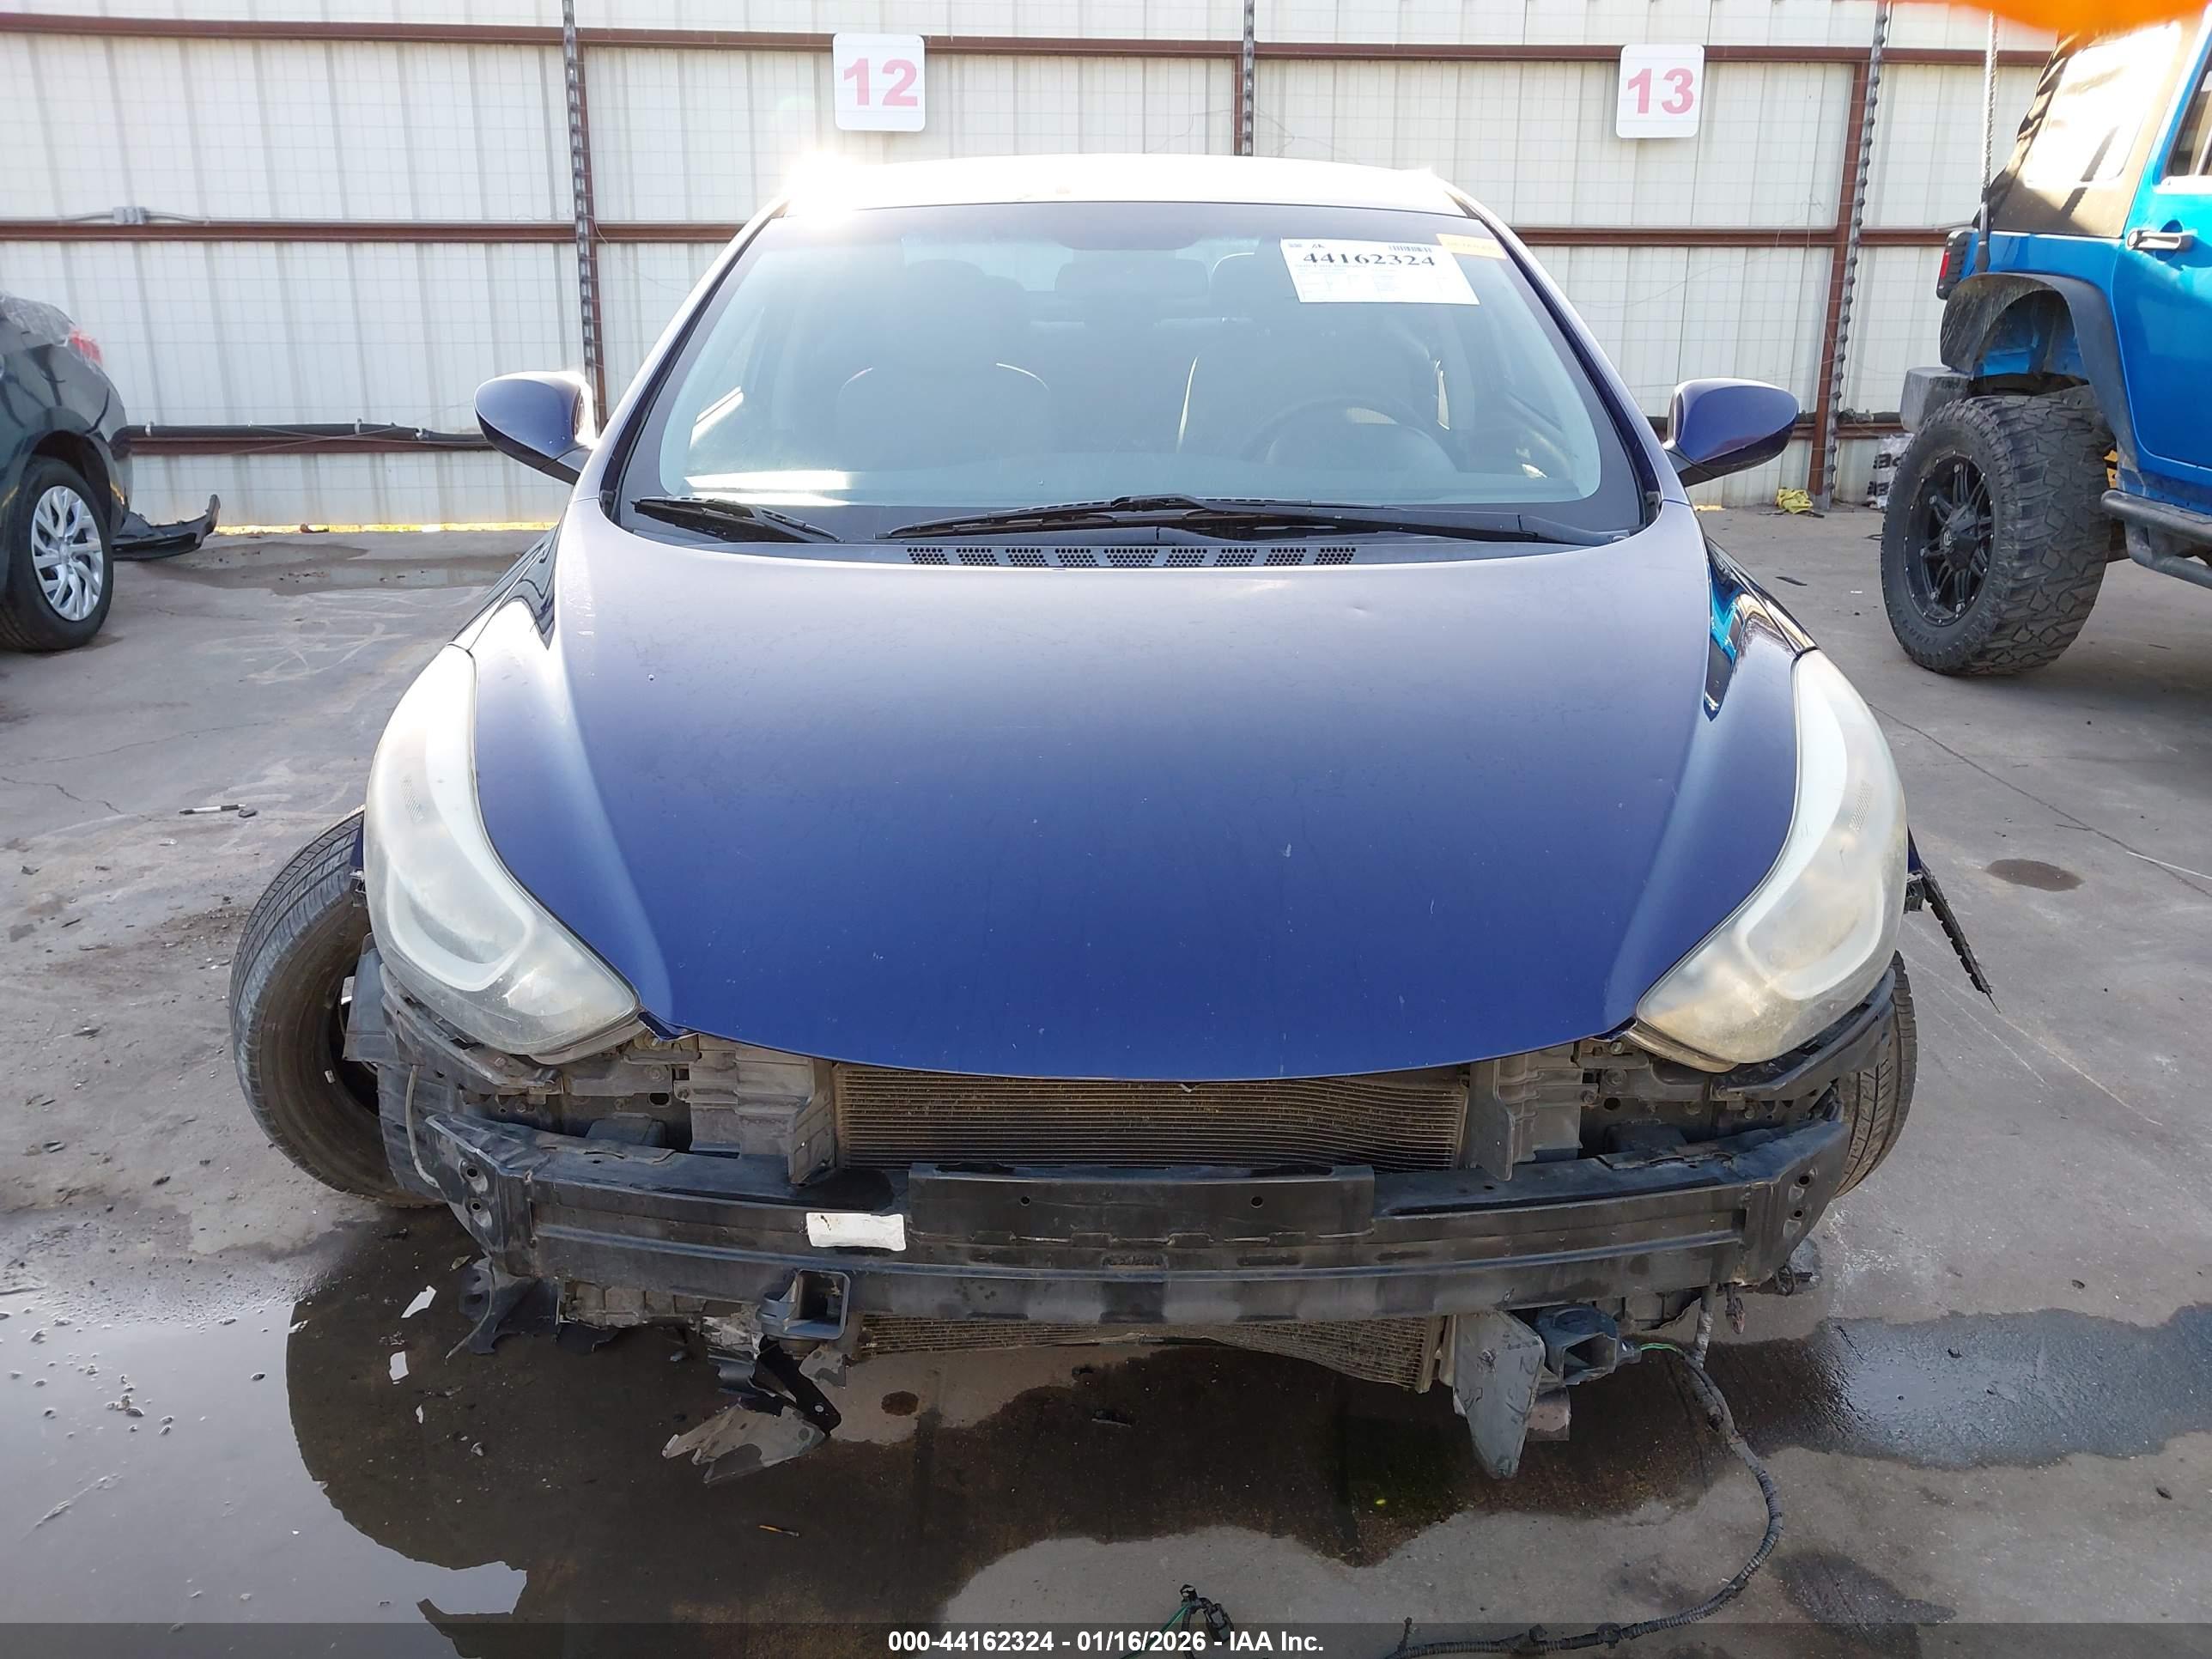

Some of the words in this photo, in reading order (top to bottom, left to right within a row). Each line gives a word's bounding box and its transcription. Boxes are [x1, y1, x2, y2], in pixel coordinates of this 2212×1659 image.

[843, 58, 918, 107] 12
[1627, 68, 1694, 114] 13
[1303, 252, 1436, 267] 44162324
